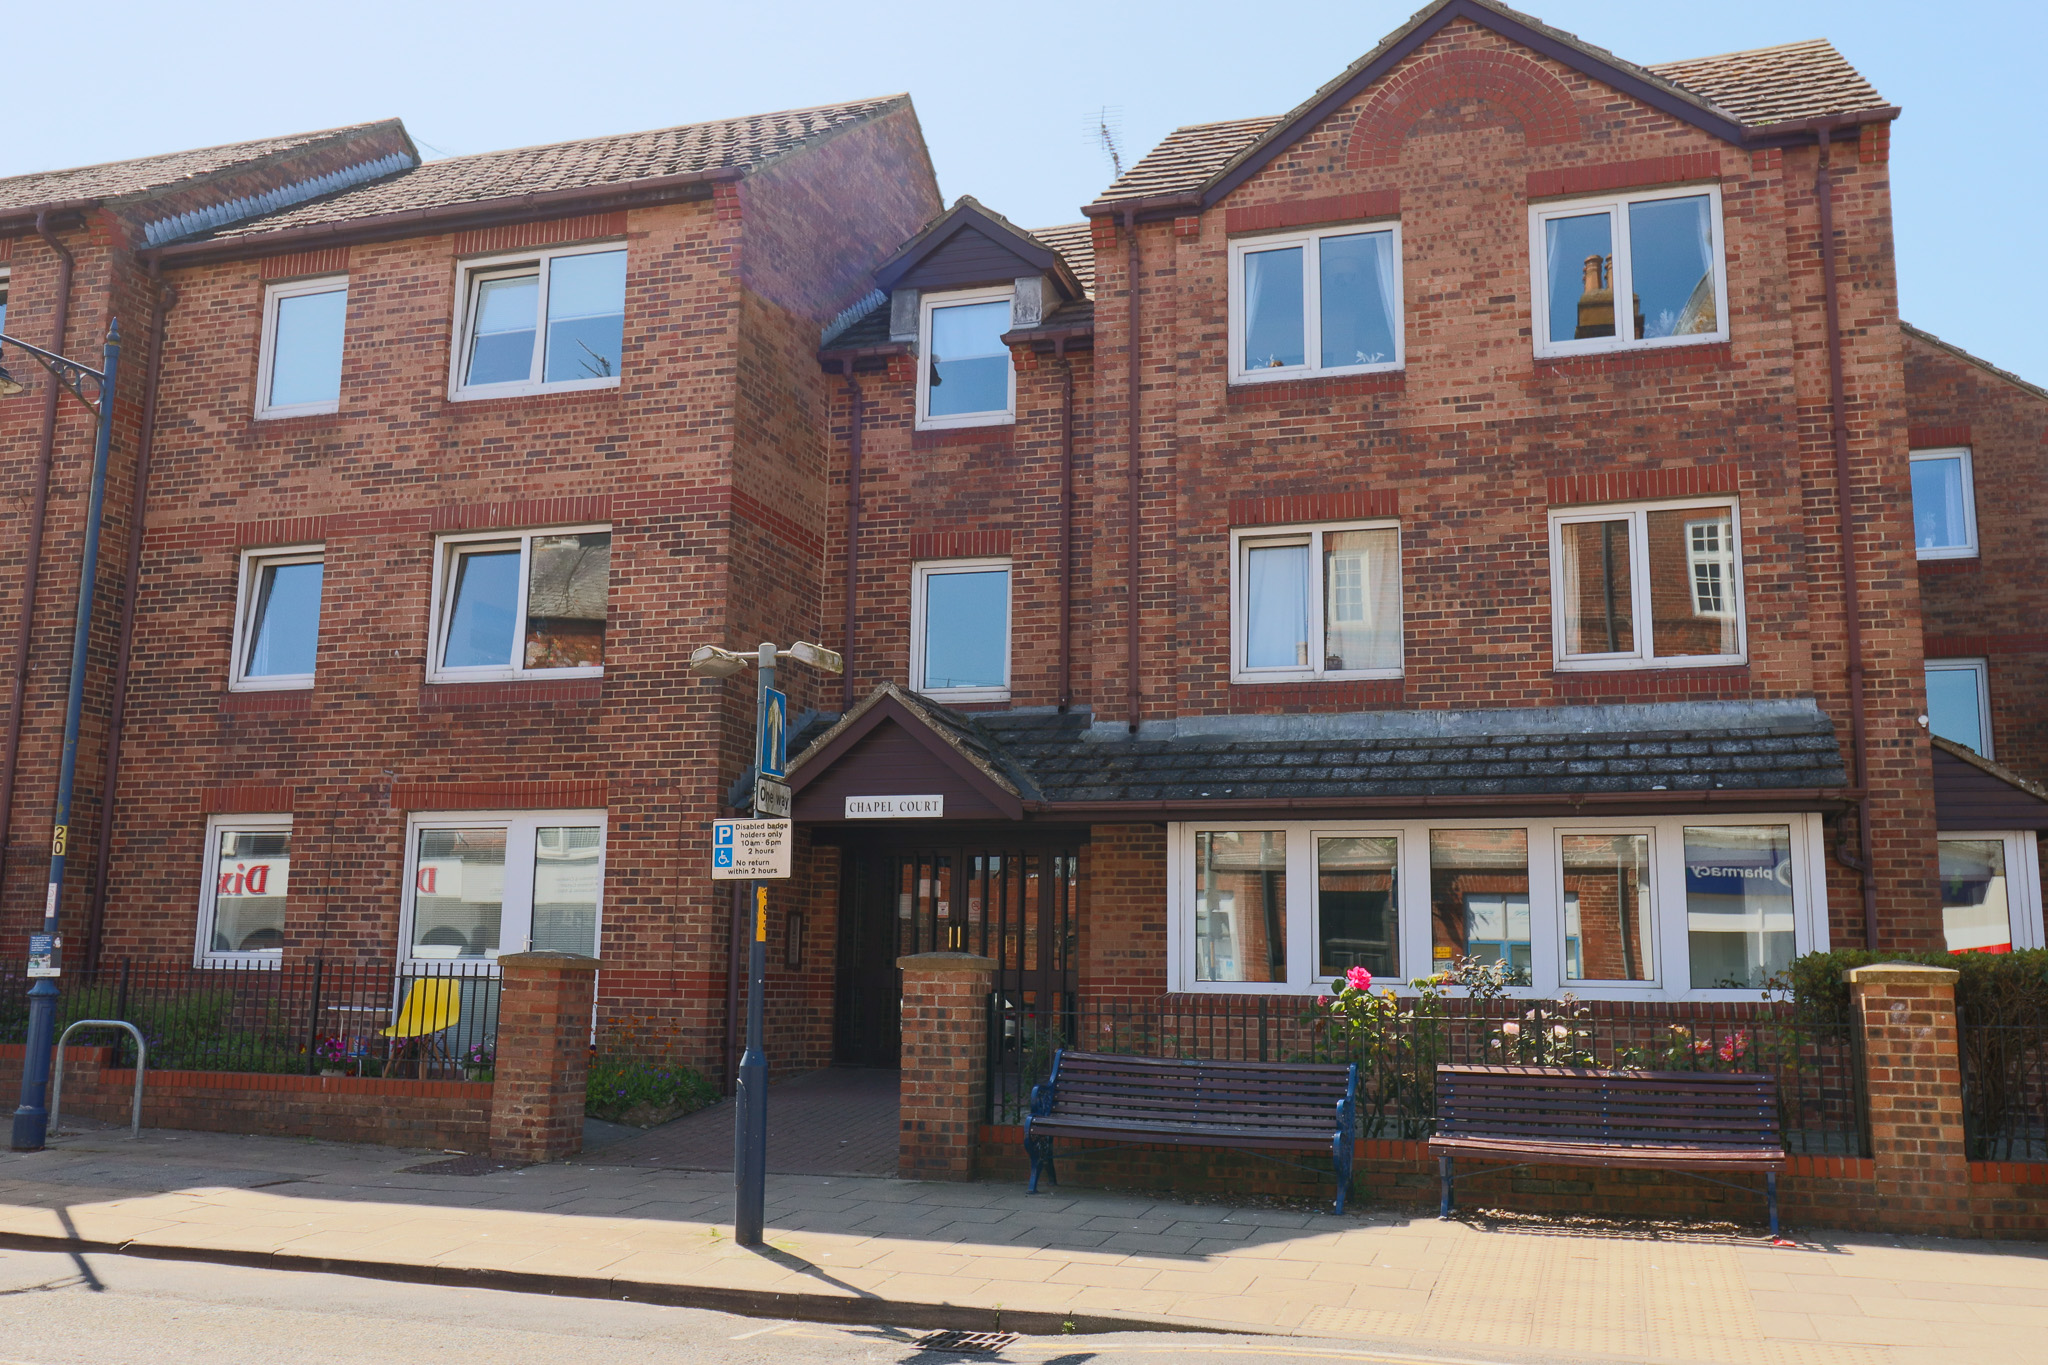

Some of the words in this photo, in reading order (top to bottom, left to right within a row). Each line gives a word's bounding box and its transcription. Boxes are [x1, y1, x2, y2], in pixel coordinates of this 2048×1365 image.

[761, 787, 773, 804] One
[776, 796, 789, 810] way
[849, 801, 893, 813] CHAPEL
[900, 801, 939, 812] COURT
[735, 823, 765, 831] Disabled
[767, 823, 788, 831] badge
[719, 826, 731, 844] P
[740, 831, 766, 839] holders
[768, 831, 782, 839] only
